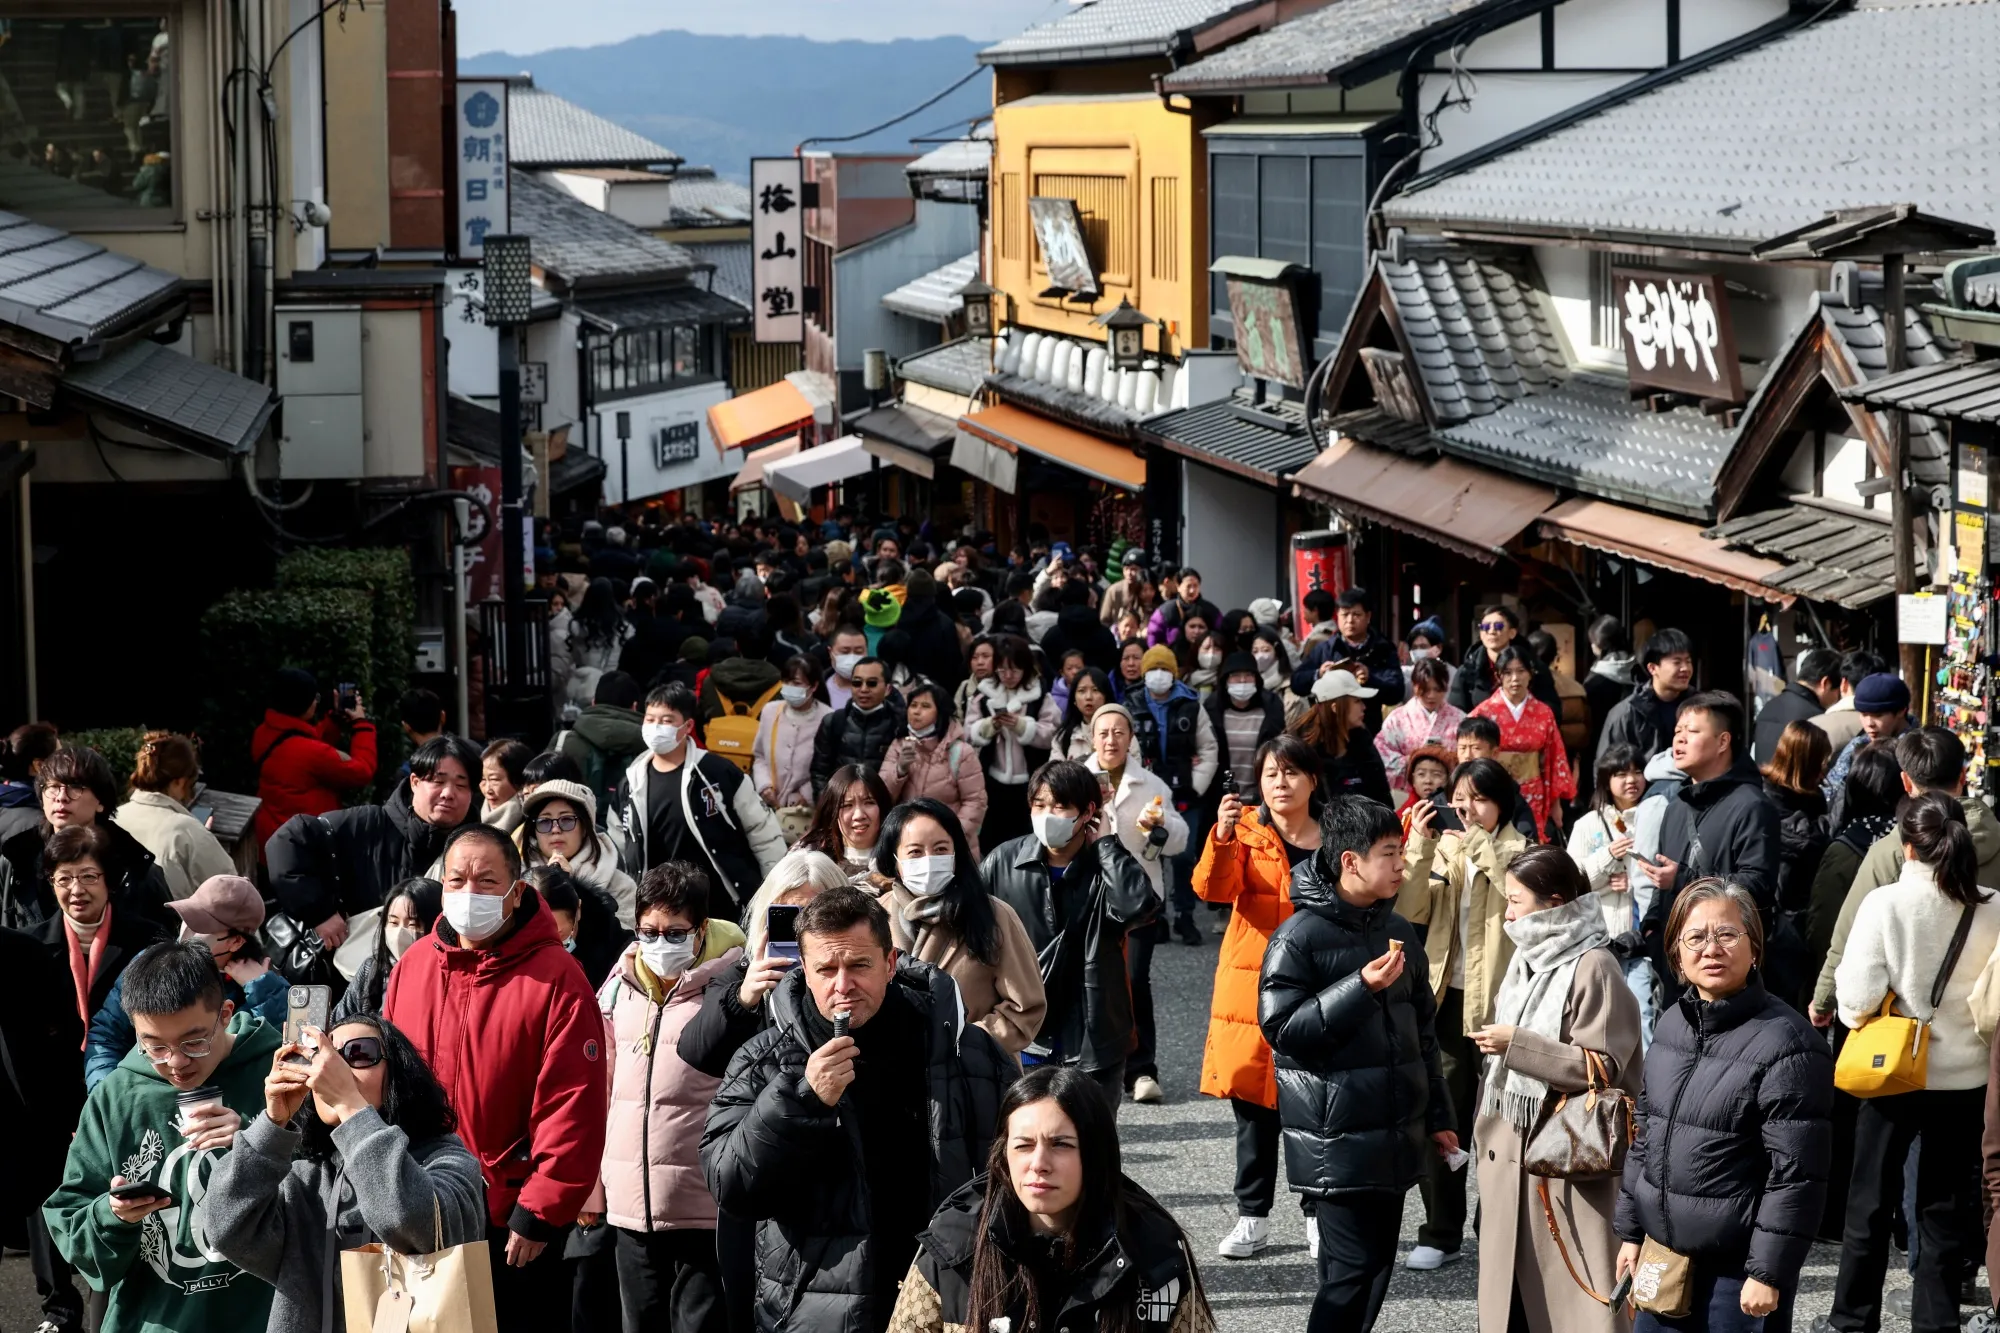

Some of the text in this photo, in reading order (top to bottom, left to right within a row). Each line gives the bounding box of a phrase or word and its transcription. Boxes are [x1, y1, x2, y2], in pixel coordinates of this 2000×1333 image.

[463, 135, 492, 247] 朝日堂
[760, 183, 800, 319] 梅山堂
[190, 1278, 222, 1291] BALLY
